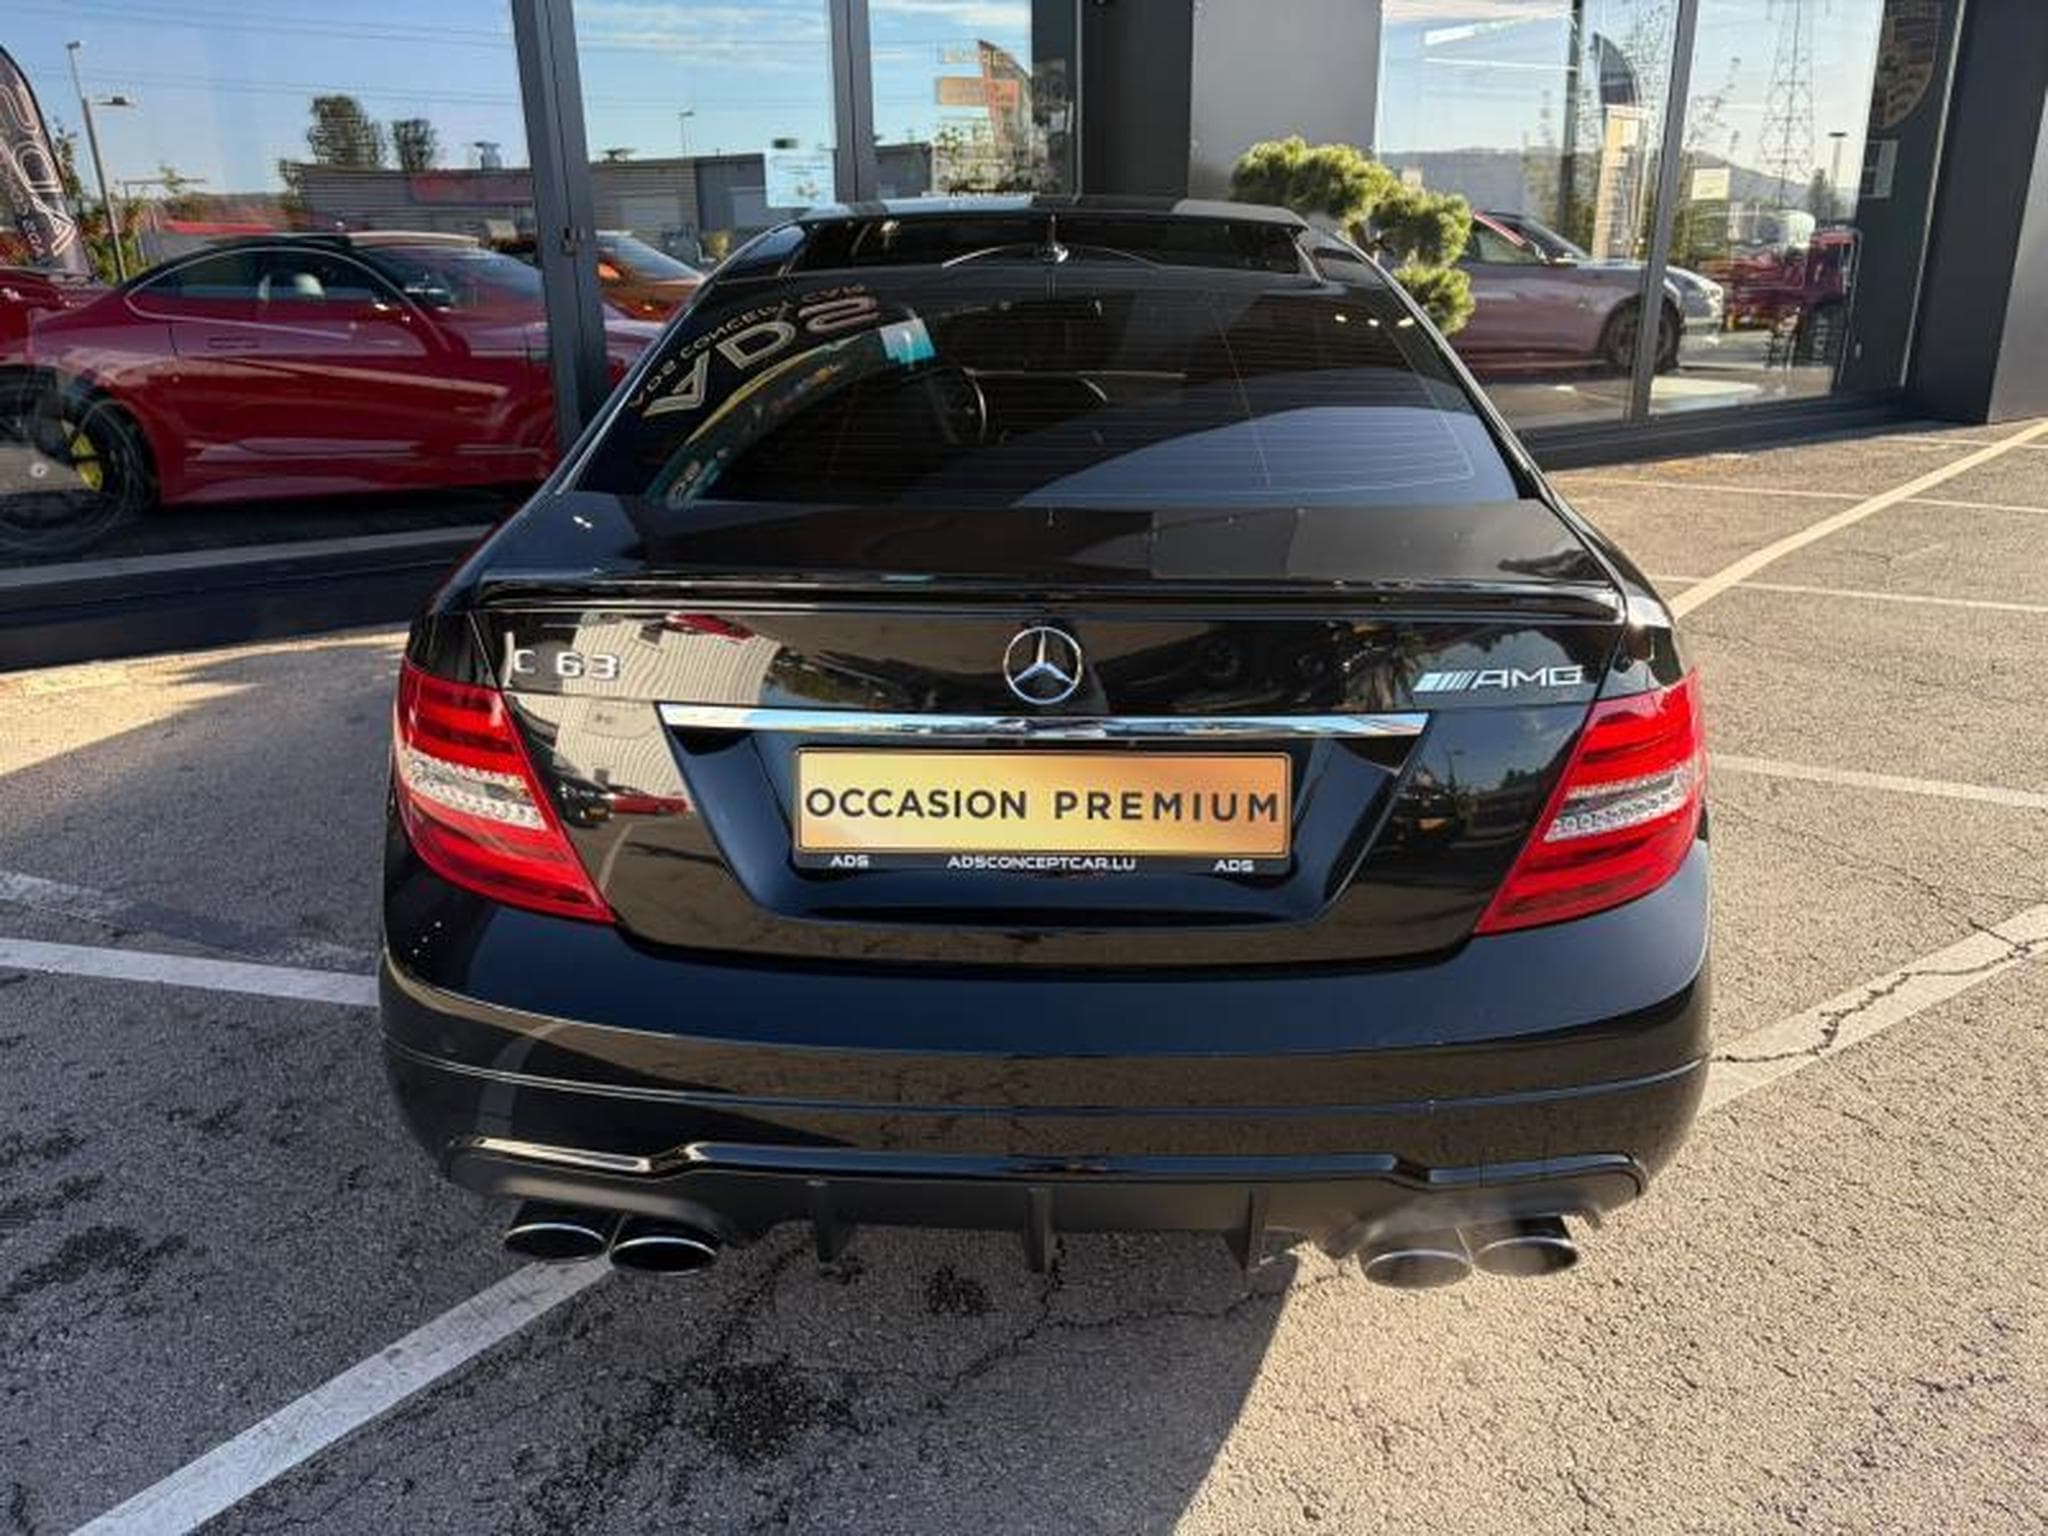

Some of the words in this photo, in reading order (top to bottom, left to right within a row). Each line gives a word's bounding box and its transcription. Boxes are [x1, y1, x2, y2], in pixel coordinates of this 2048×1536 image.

[514, 649, 535, 674] C
[556, 651, 618, 679] 63
[1470, 665, 1583, 690] AMG
[805, 788, 1027, 819] OCCASION
[1054, 790, 1279, 822] PREMIUM
[829, 855, 870, 868] ADS
[946, 856, 1137, 871] ADSCONCEPTCAR.LU
[1213, 859, 1255, 873] ADS
